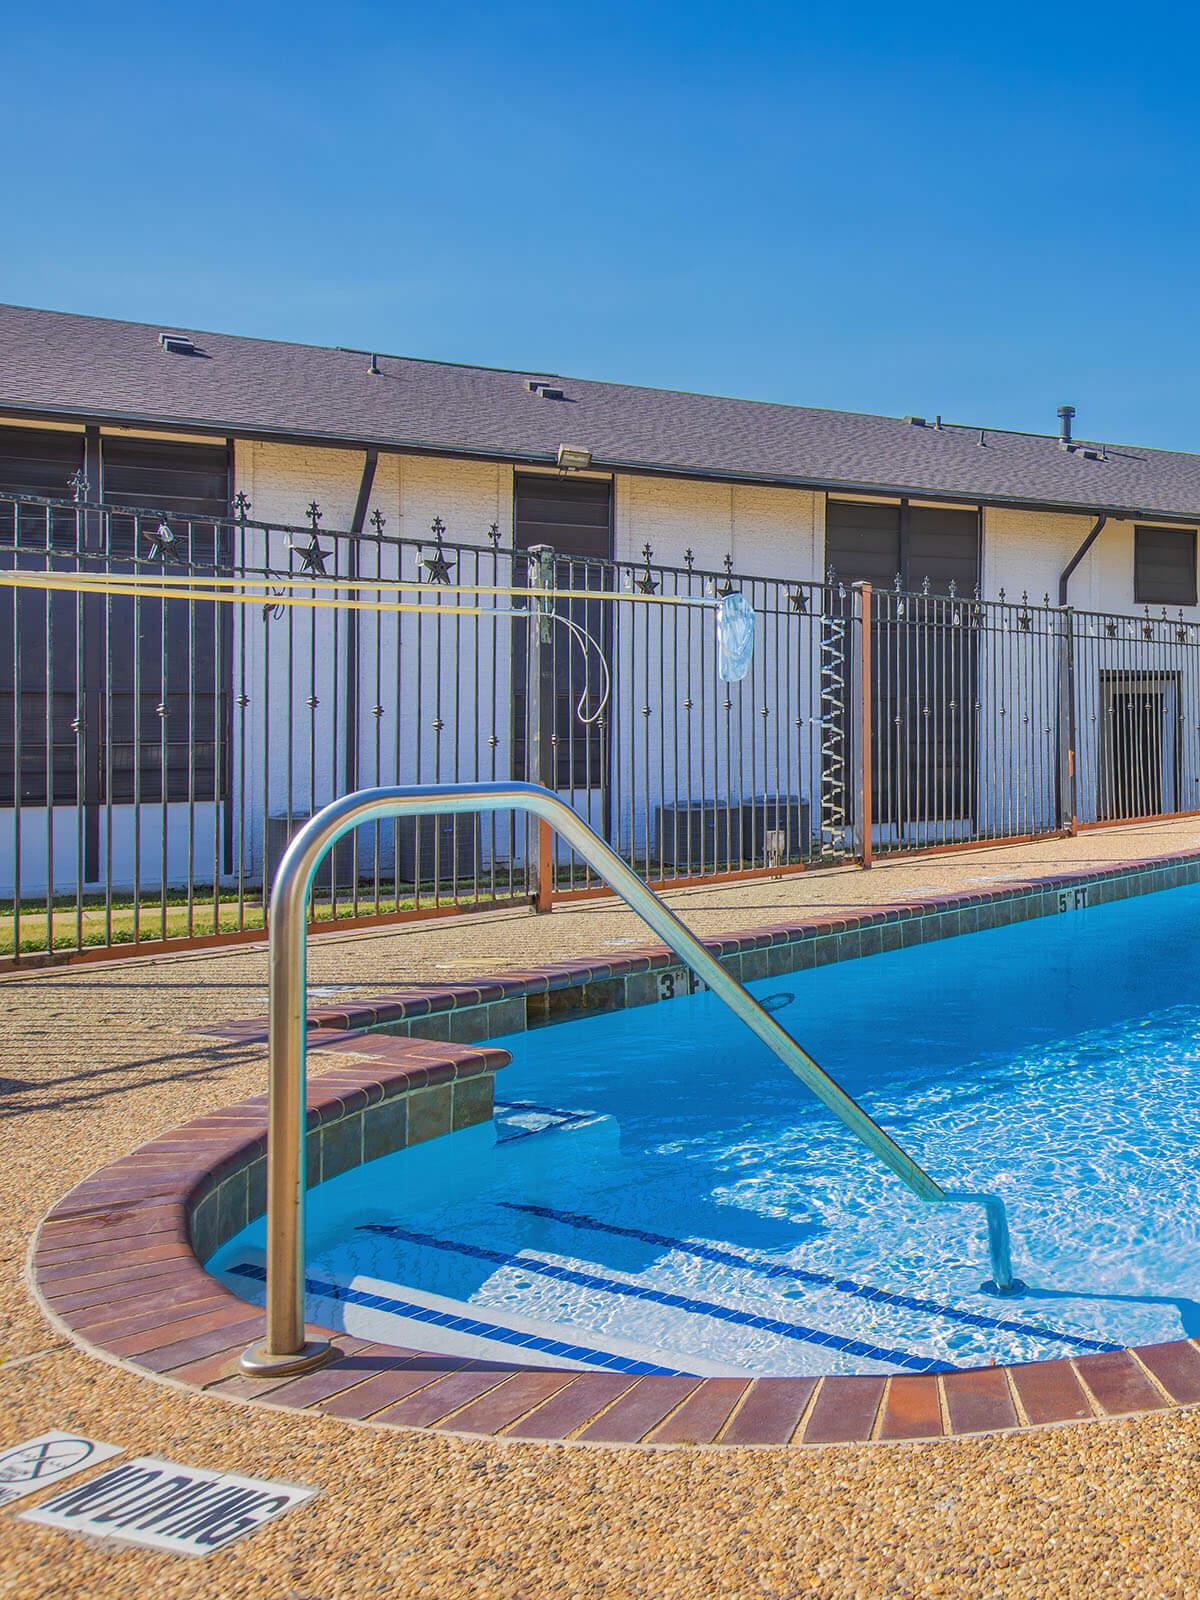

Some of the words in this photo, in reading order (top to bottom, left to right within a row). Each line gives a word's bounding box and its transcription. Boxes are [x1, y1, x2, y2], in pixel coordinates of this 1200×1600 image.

[1059, 894, 1067, 912] 5
[1074, 887, 1087, 910] FT
[661, 974, 674, 1000] 3
[38, 1465, 163, 1518] NO
[91, 1475, 291, 1546] DIVING
